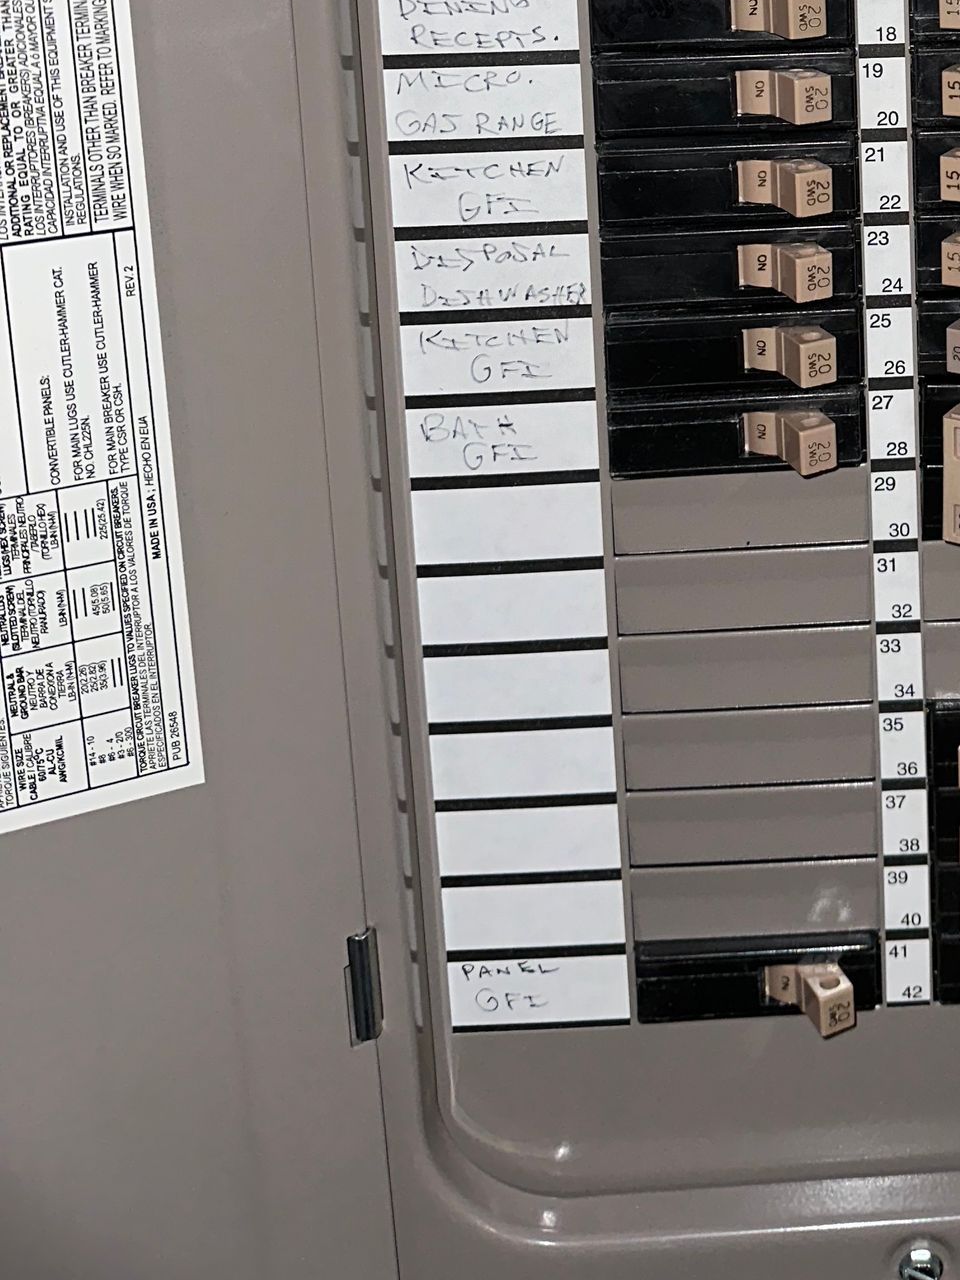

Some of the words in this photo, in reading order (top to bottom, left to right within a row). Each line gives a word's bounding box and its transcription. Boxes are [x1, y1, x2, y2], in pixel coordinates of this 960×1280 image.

[876, 26, 897, 42] 18
[396, 70, 534, 95] MICRO.
[395, 110, 463, 136] GAS
[475, 111, 562, 135] RANGE
[877, 110, 899, 127] 20
[864, 146, 884, 163] 21
[403, 154, 565, 189] KITCHEN
[457, 191, 539, 222] GFI
[879, 194, 901, 210] 22
[411, 241, 570, 272] DISPOSAL
[52, 266, 64, 289] CAT.
[124, 274, 137, 298] REV.
[421, 282, 587, 308] DISHWASHER
[54, 289, 73, 379] CUTLER-HAMMER
[419, 320, 569, 354] KITCHEN
[470, 353, 553, 384] GFI
[39, 374, 54, 417] PANELS:
[64, 379, 76, 402] USE
[66, 403, 79, 431] LUGS
[420, 412, 517, 442] BATH
[44, 416, 61, 486] CONVERTIBLE
[69, 432, 81, 459] MAIN
[462, 441, 538, 470] GFI
[886, 441, 908, 457] 28
[73, 459, 84, 482] FOR
[874, 476, 896, 492] 29
[889, 522, 910, 538] 30
[151, 533, 162, 560] MADE
[891, 603, 913, 619] 32
[879, 638, 901, 654] 33
[894, 683, 915, 698] 34
[168, 710, 179, 740] 26548
[882, 717, 904, 732] 35
[172, 741, 182, 761] PUB
[461, 959, 561, 981] PANEL
[474, 986, 550, 1012] GFI
